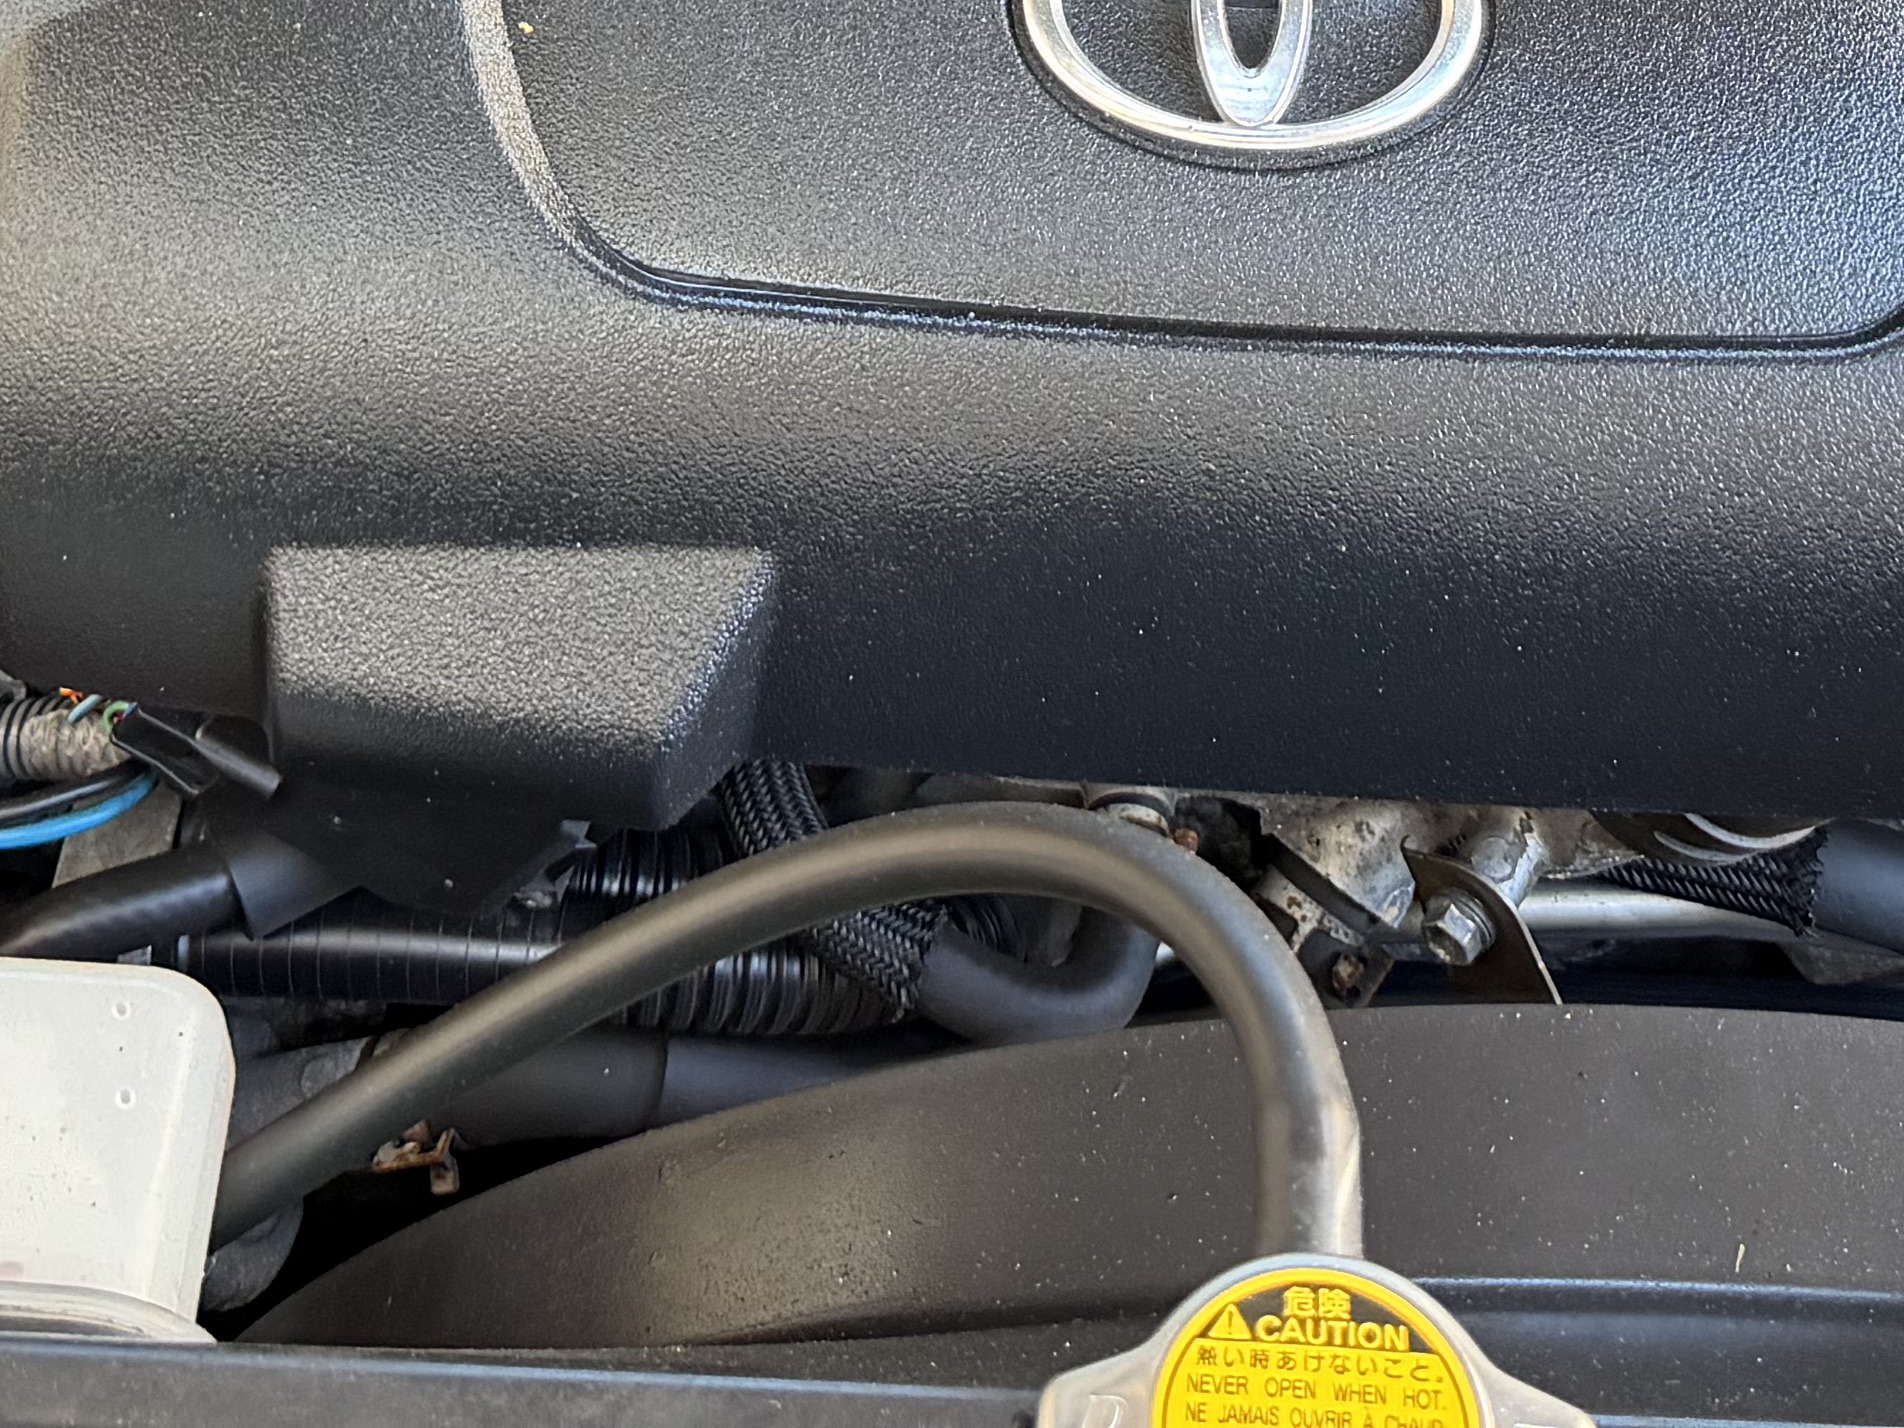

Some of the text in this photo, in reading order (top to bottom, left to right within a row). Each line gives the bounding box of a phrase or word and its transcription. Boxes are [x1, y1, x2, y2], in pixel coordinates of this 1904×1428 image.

[1283, 1286, 1353, 1320] 危険
[1254, 1314, 1410, 1353] CAUTION
[1186, 1373, 1249, 1395] NEVER
[1264, 1376, 1317, 1400] OPEN
[1332, 1381, 1387, 1405] WHEN
[1185, 1401, 1207, 1424] NE
[1217, 1404, 1280, 1426] JAMAIS
[1289, 1407, 1353, 1428] OUVRIR
[1362, 1406, 1374, 1428] À
